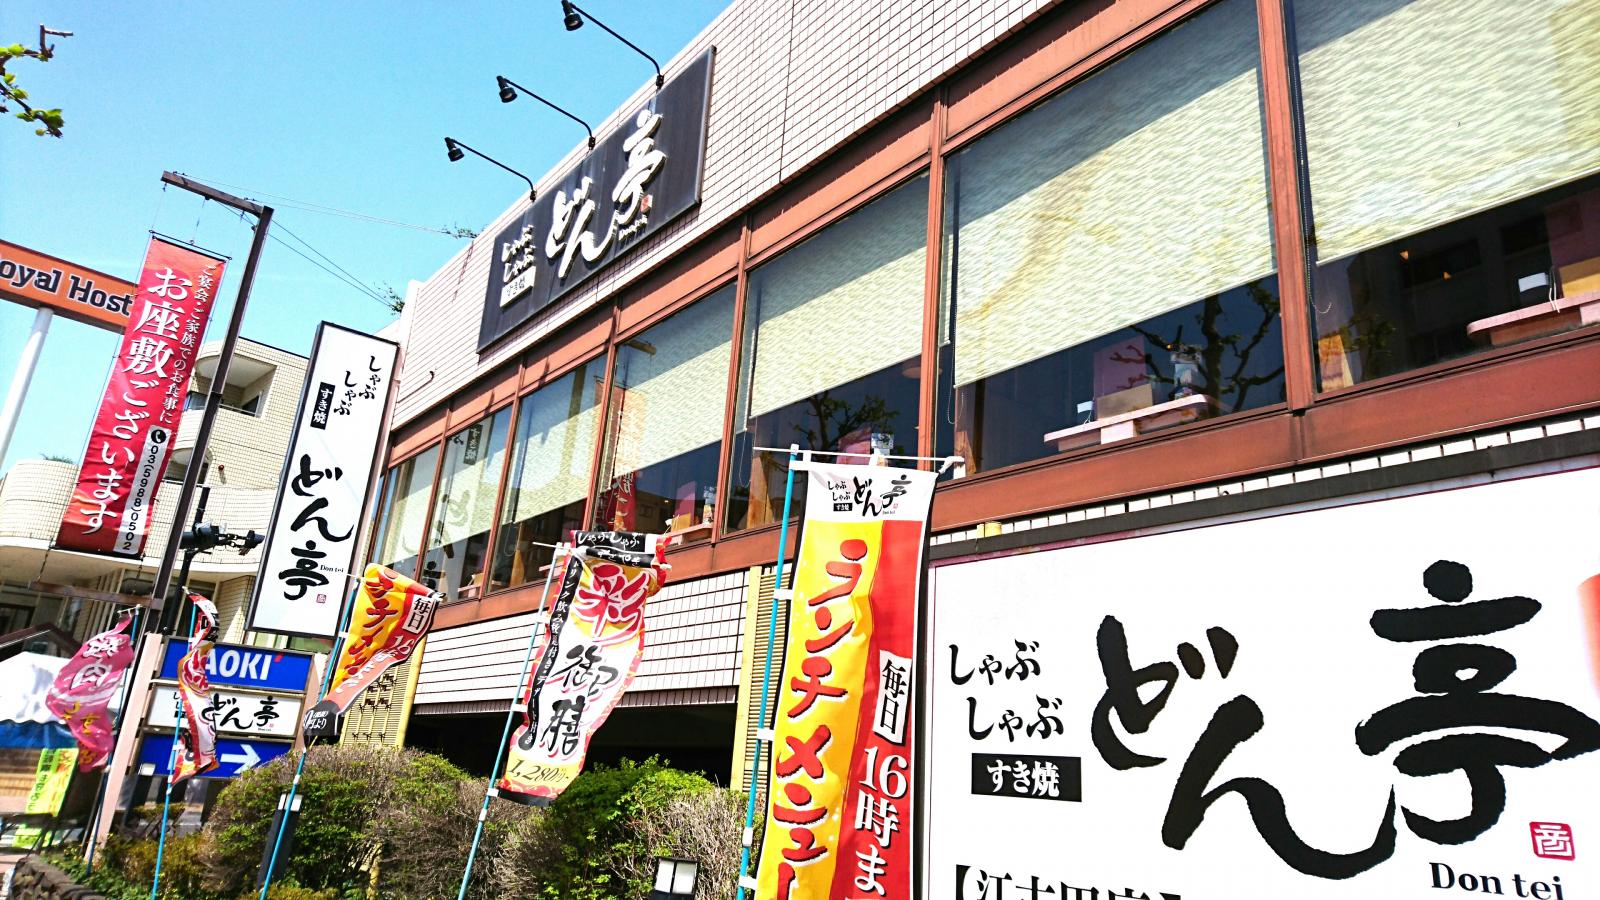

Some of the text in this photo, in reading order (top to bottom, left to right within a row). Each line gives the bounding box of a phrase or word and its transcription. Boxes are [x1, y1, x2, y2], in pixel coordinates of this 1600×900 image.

[68, 275, 133, 316] Host
[333, 370, 358, 416] しゃぶ
[358, 355, 382, 400] しゃぶ
[80, 267, 193, 535] お座敷ございます
[312, 388, 333, 425] すき焼
[853, 474, 912, 517] どん亭
[278, 453, 355, 601] どん亭
[205, 648, 273, 680] AOKI
[949, 639, 1041, 686] しゃぶ
[966, 694, 1065, 743] しゃぶ
[1091, 560, 1600, 880] どん亭
[986, 759, 1060, 798] すき焼
[1429, 862, 1504, 895] Don
